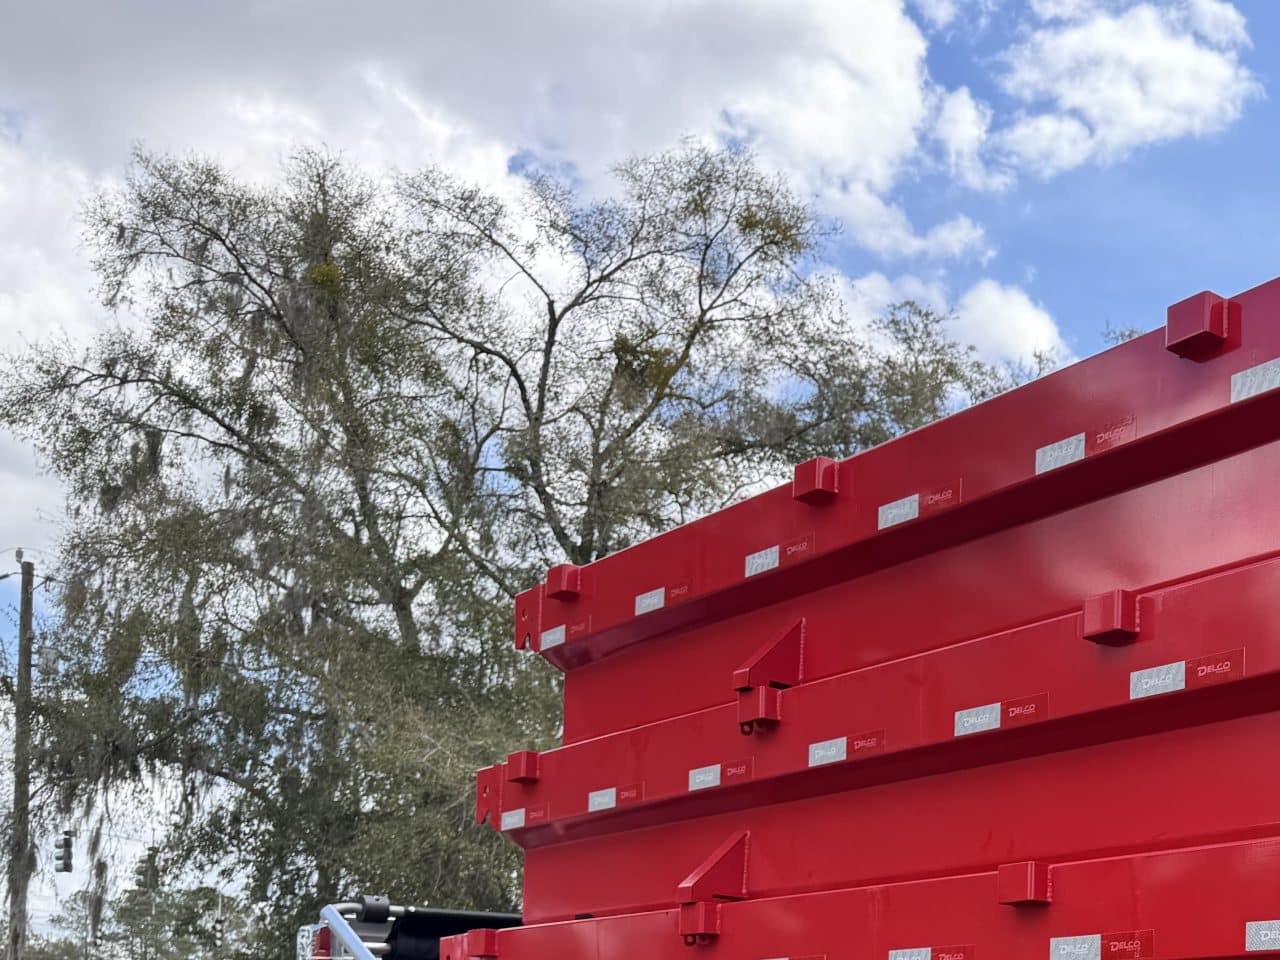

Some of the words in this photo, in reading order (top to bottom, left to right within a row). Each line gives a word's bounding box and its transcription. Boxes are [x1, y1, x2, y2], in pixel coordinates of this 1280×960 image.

[1197, 661, 1231, 677] DELCO
[1008, 704, 1036, 717] DELCO
[1110, 940, 1141, 952] DELCO
